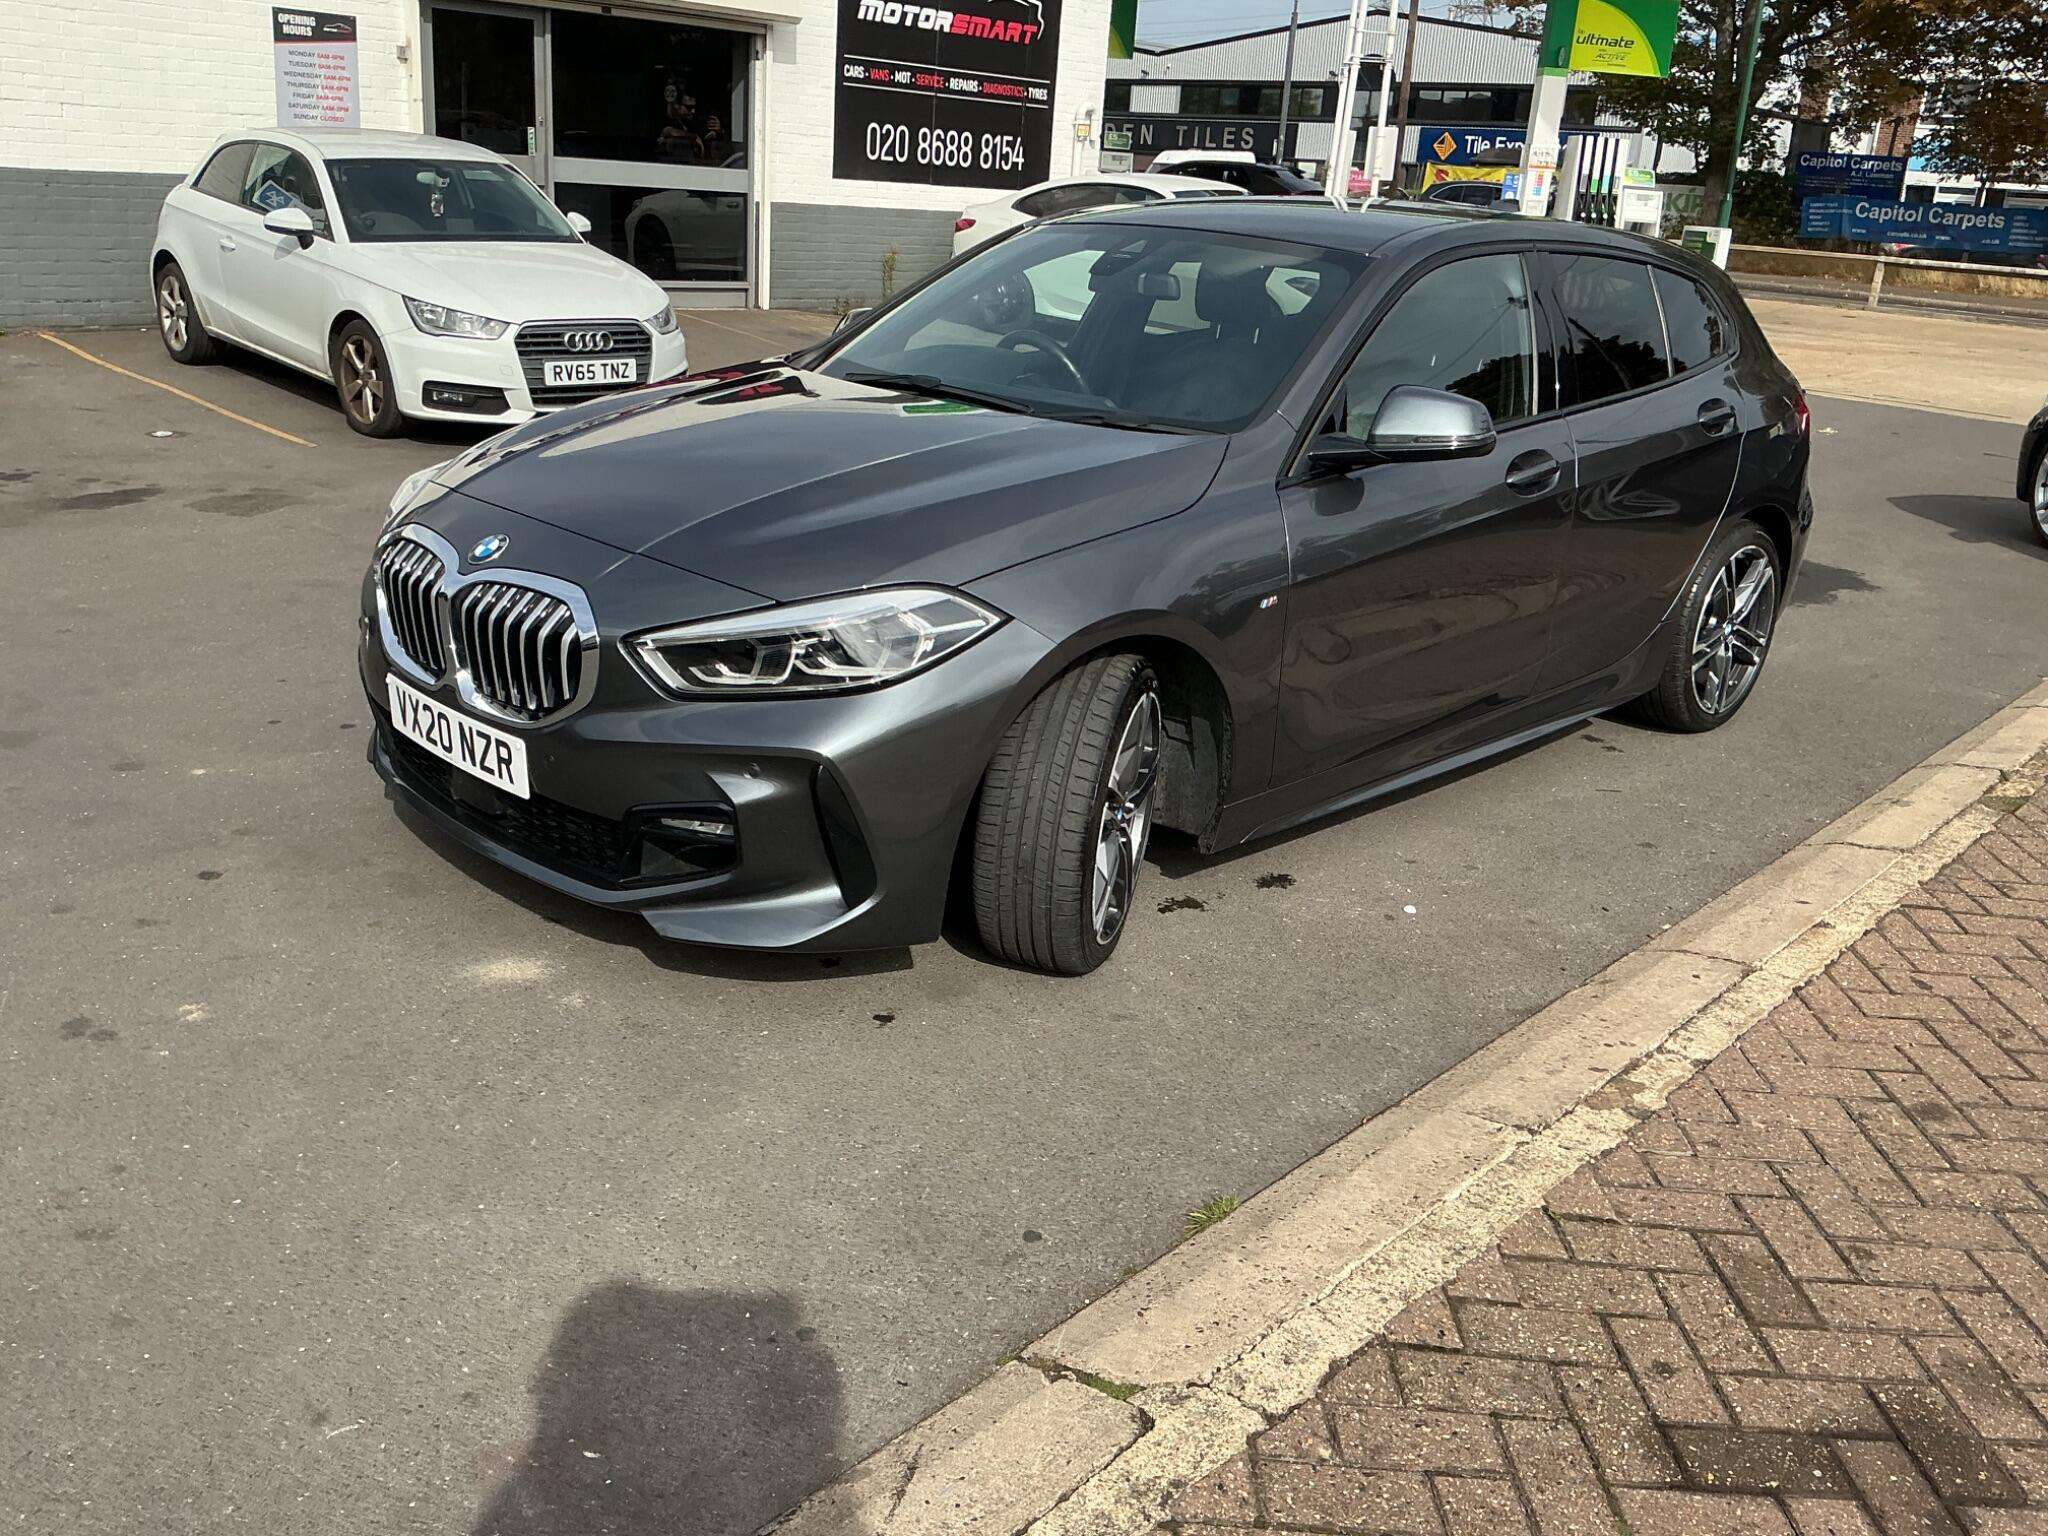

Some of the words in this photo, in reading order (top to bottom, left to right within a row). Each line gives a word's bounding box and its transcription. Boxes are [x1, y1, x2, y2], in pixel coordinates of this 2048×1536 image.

[278, 13, 316, 26] OPENING
[857, 0, 1038, 45] MOTORSMART
[283, 25, 312, 36] HOURS
[1576, 33, 1635, 48] ultimate
[288, 50, 315, 58] MONDAY
[1595, 53, 1626, 61] ACTIVE
[288, 60, 316, 68] TUESDAY
[283, 71, 322, 80] WEDNESDAY
[843, 64, 865, 79] CARS
[870, 68, 890, 82] VANS
[895, 71, 911, 85] MOT
[916, 74, 945, 88] SERVICE
[950, 78, 979, 93] REPAIRS
[983, 82, 1025, 98] DIAGNOSTICS
[1028, 87, 1049, 101] TYRES
[286, 82, 319, 90] THURSDAY
[288, 102, 320, 110] SATURDAY
[1175, 125, 1256, 150] TILES
[1464, 135, 1490, 154] Tile
[866, 122, 909, 163] 020
[916, 127, 973, 168] 8688
[979, 133, 1025, 171] 8154
[1800, 154, 1847, 169] Capitol
[1850, 157, 1904, 172] Carpets
[1855, 201, 1922, 223] Capitol
[1928, 207, 2006, 230] Carpets
[554, 361, 595, 382] RV65
[600, 362, 630, 380] TNZ
[397, 685, 453, 753] VX20
[459, 721, 515, 785] NZR
